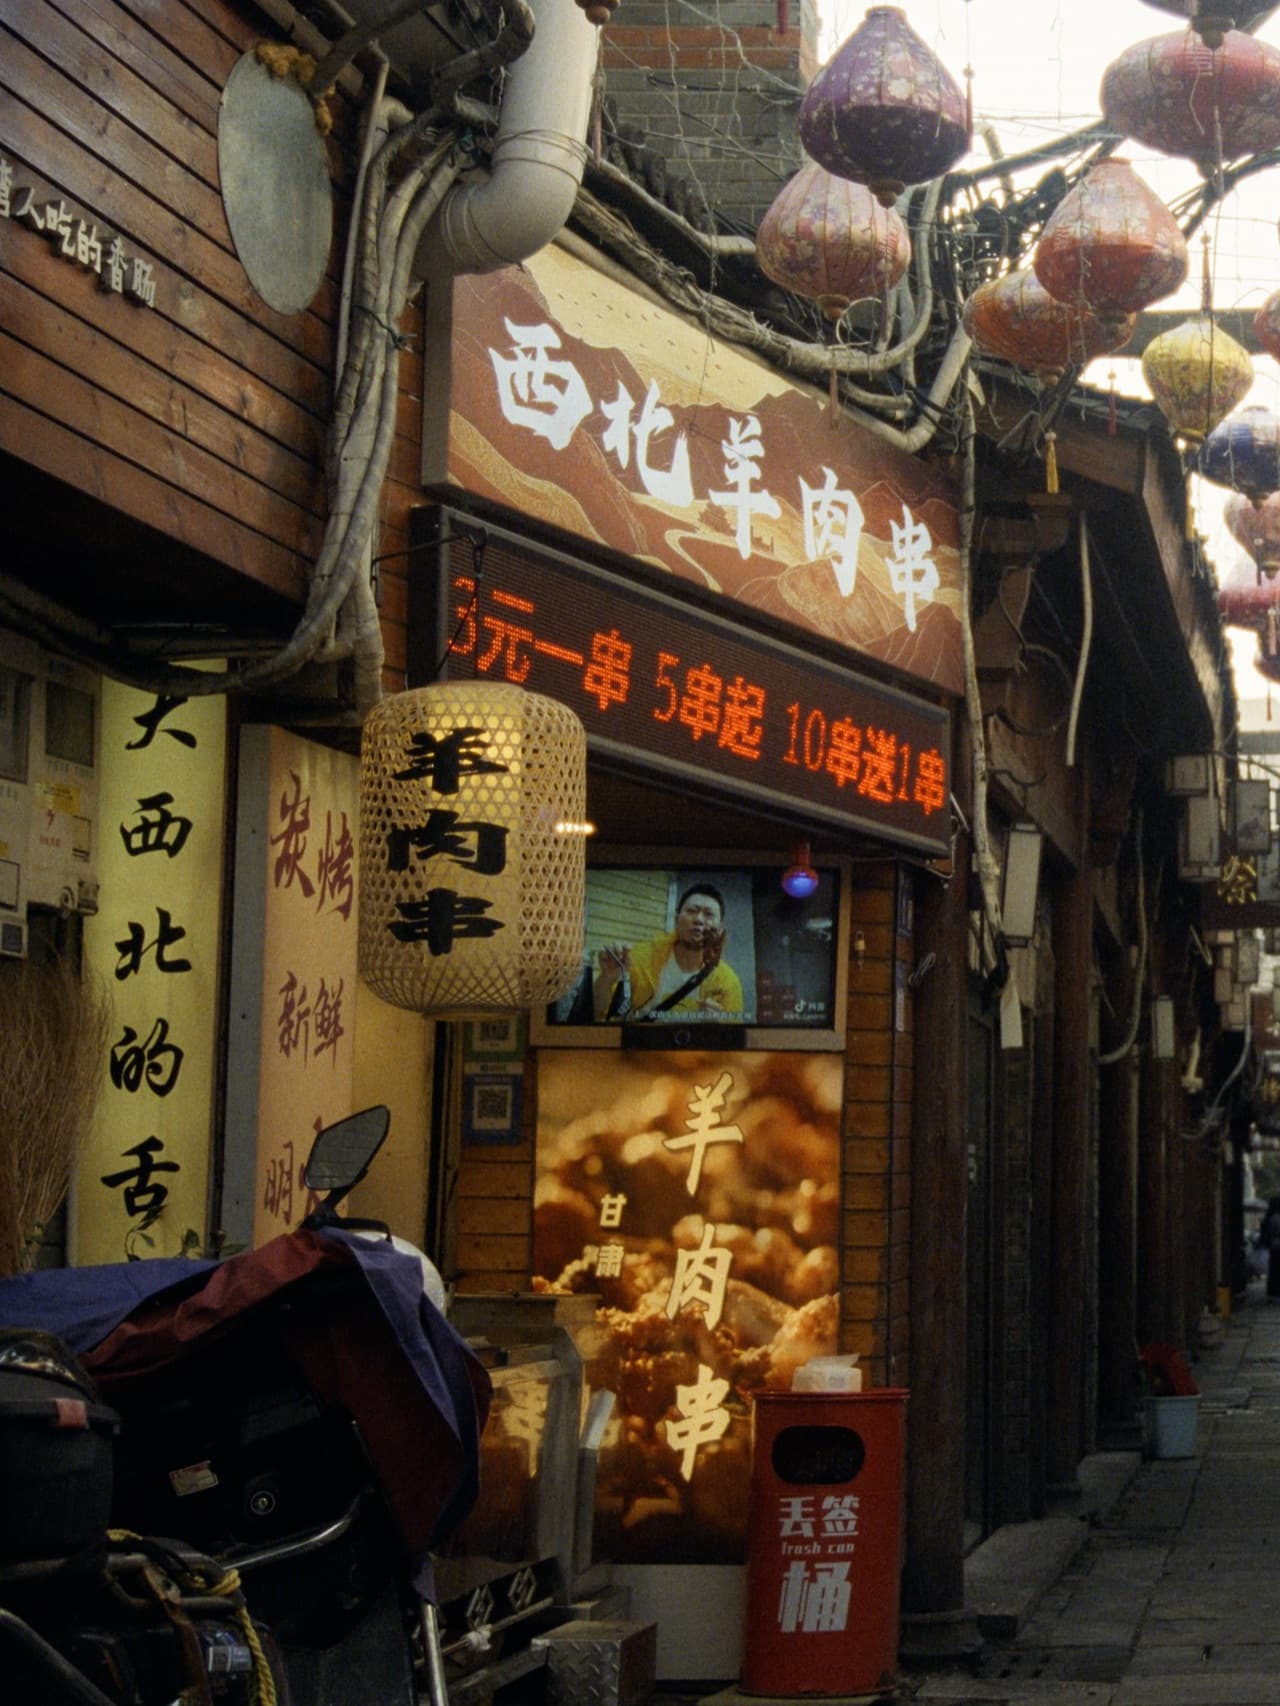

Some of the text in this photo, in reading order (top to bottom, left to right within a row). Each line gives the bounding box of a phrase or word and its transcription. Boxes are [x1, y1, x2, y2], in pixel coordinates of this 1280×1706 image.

[488, 317, 941, 632] 西北羊肉串
[448, 576, 946, 815] 3元一串 5串起 10串送1串
[270, 768, 355, 921] 炭烤
[386, 727, 508, 956] 羊肉串
[278, 969, 344, 1070] 新鲜
[595, 1192, 628, 1280] 甘肃
[663, 1072, 744, 1482] 羊肉串
[779, 1495, 860, 1538] 丢签
[777, 1560, 853, 1633] 桶
